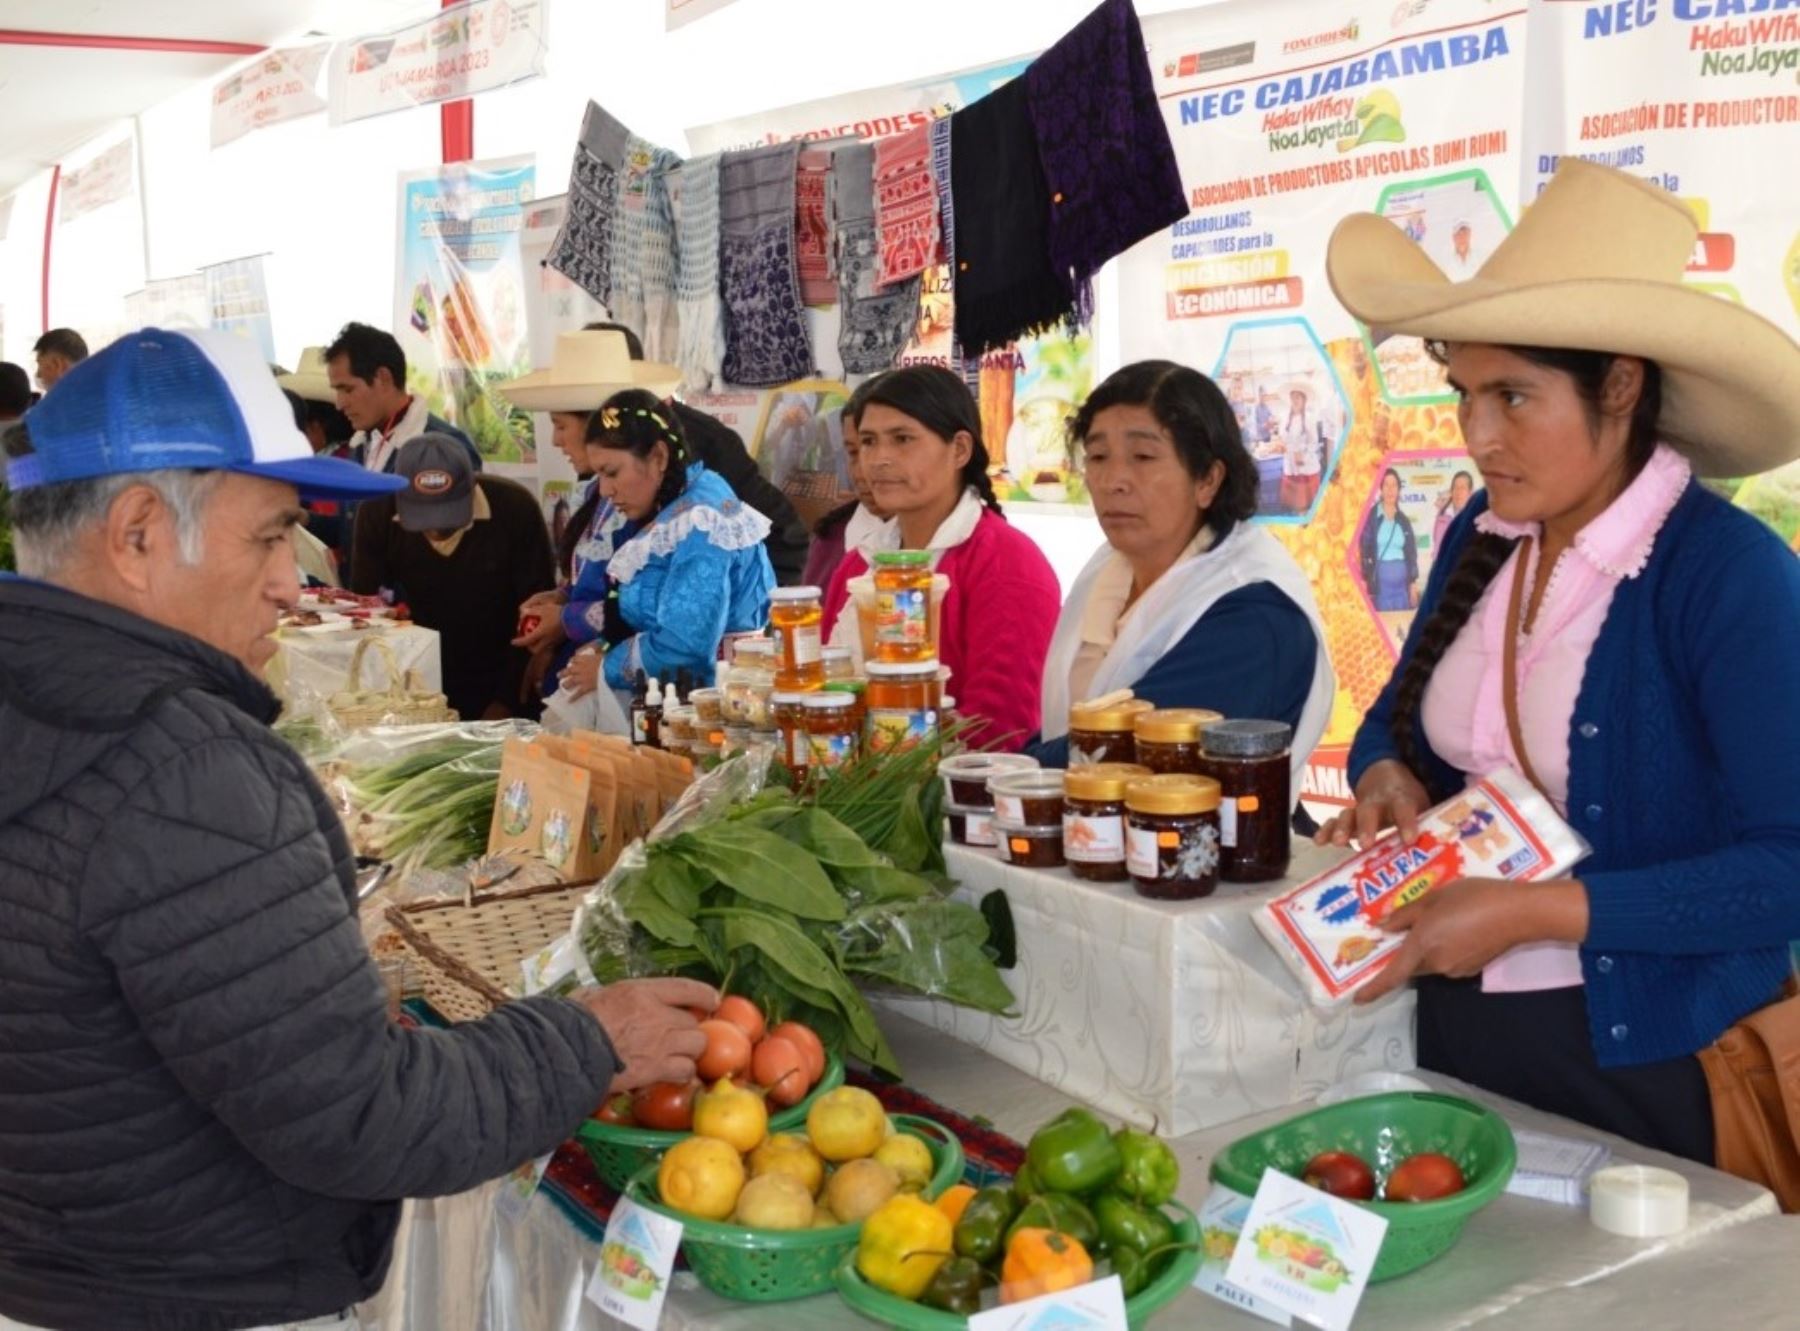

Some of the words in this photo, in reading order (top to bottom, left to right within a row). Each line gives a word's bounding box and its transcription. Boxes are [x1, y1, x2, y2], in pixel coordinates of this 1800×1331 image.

[1584, 0, 1656, 39] NEC
[1179, 90, 1245, 126] NEC
[1255, 26, 1509, 110] CAJABAMBA
[1580, 100, 1658, 140] ASOCIACIÓN
[1664, 103, 1688, 129] DE
[1692, 96, 1800, 129] PRODUCTOR
[1192, 177, 1252, 208] ASOCIACIÓN
[1253, 175, 1267, 197] DE
[1268, 159, 1353, 195] PRODUCTORES
[1356, 146, 1430, 178] APICOLAS
[1433, 138, 1466, 167] RUMI
[1469, 130, 1508, 159] RUMI
[1663, 172, 1680, 192] la
[1172, 210, 1252, 238] DESARROLLAMOS
[1238, 235, 1261, 252] para
[1263, 231, 1273, 247] la
[1174, 283, 1291, 317] ECONÓMICA
[1362, 846, 1430, 902] ALFA
[1401, 879, 1428, 903] 100
